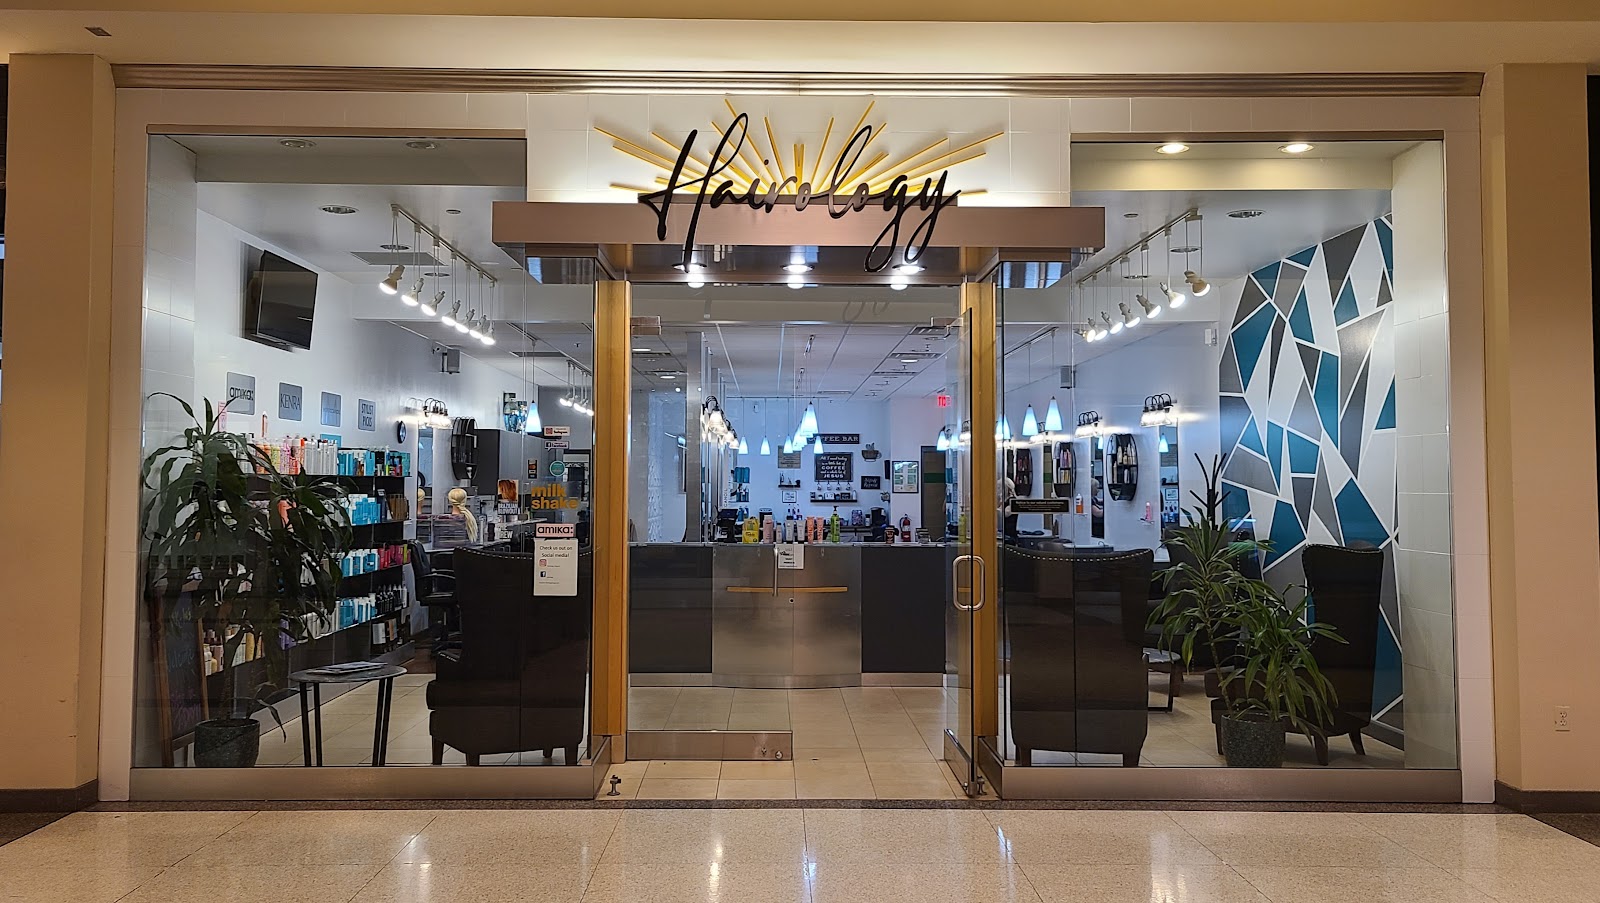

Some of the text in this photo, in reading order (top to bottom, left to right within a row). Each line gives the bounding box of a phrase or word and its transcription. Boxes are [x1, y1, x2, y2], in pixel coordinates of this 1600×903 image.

[638, 112, 961, 273] Hairology
[280, 394, 302, 410] KENRA
[531, 483, 567, 497] milk
[531, 497, 579, 510] shake
[537, 526, 574, 534] amika:
